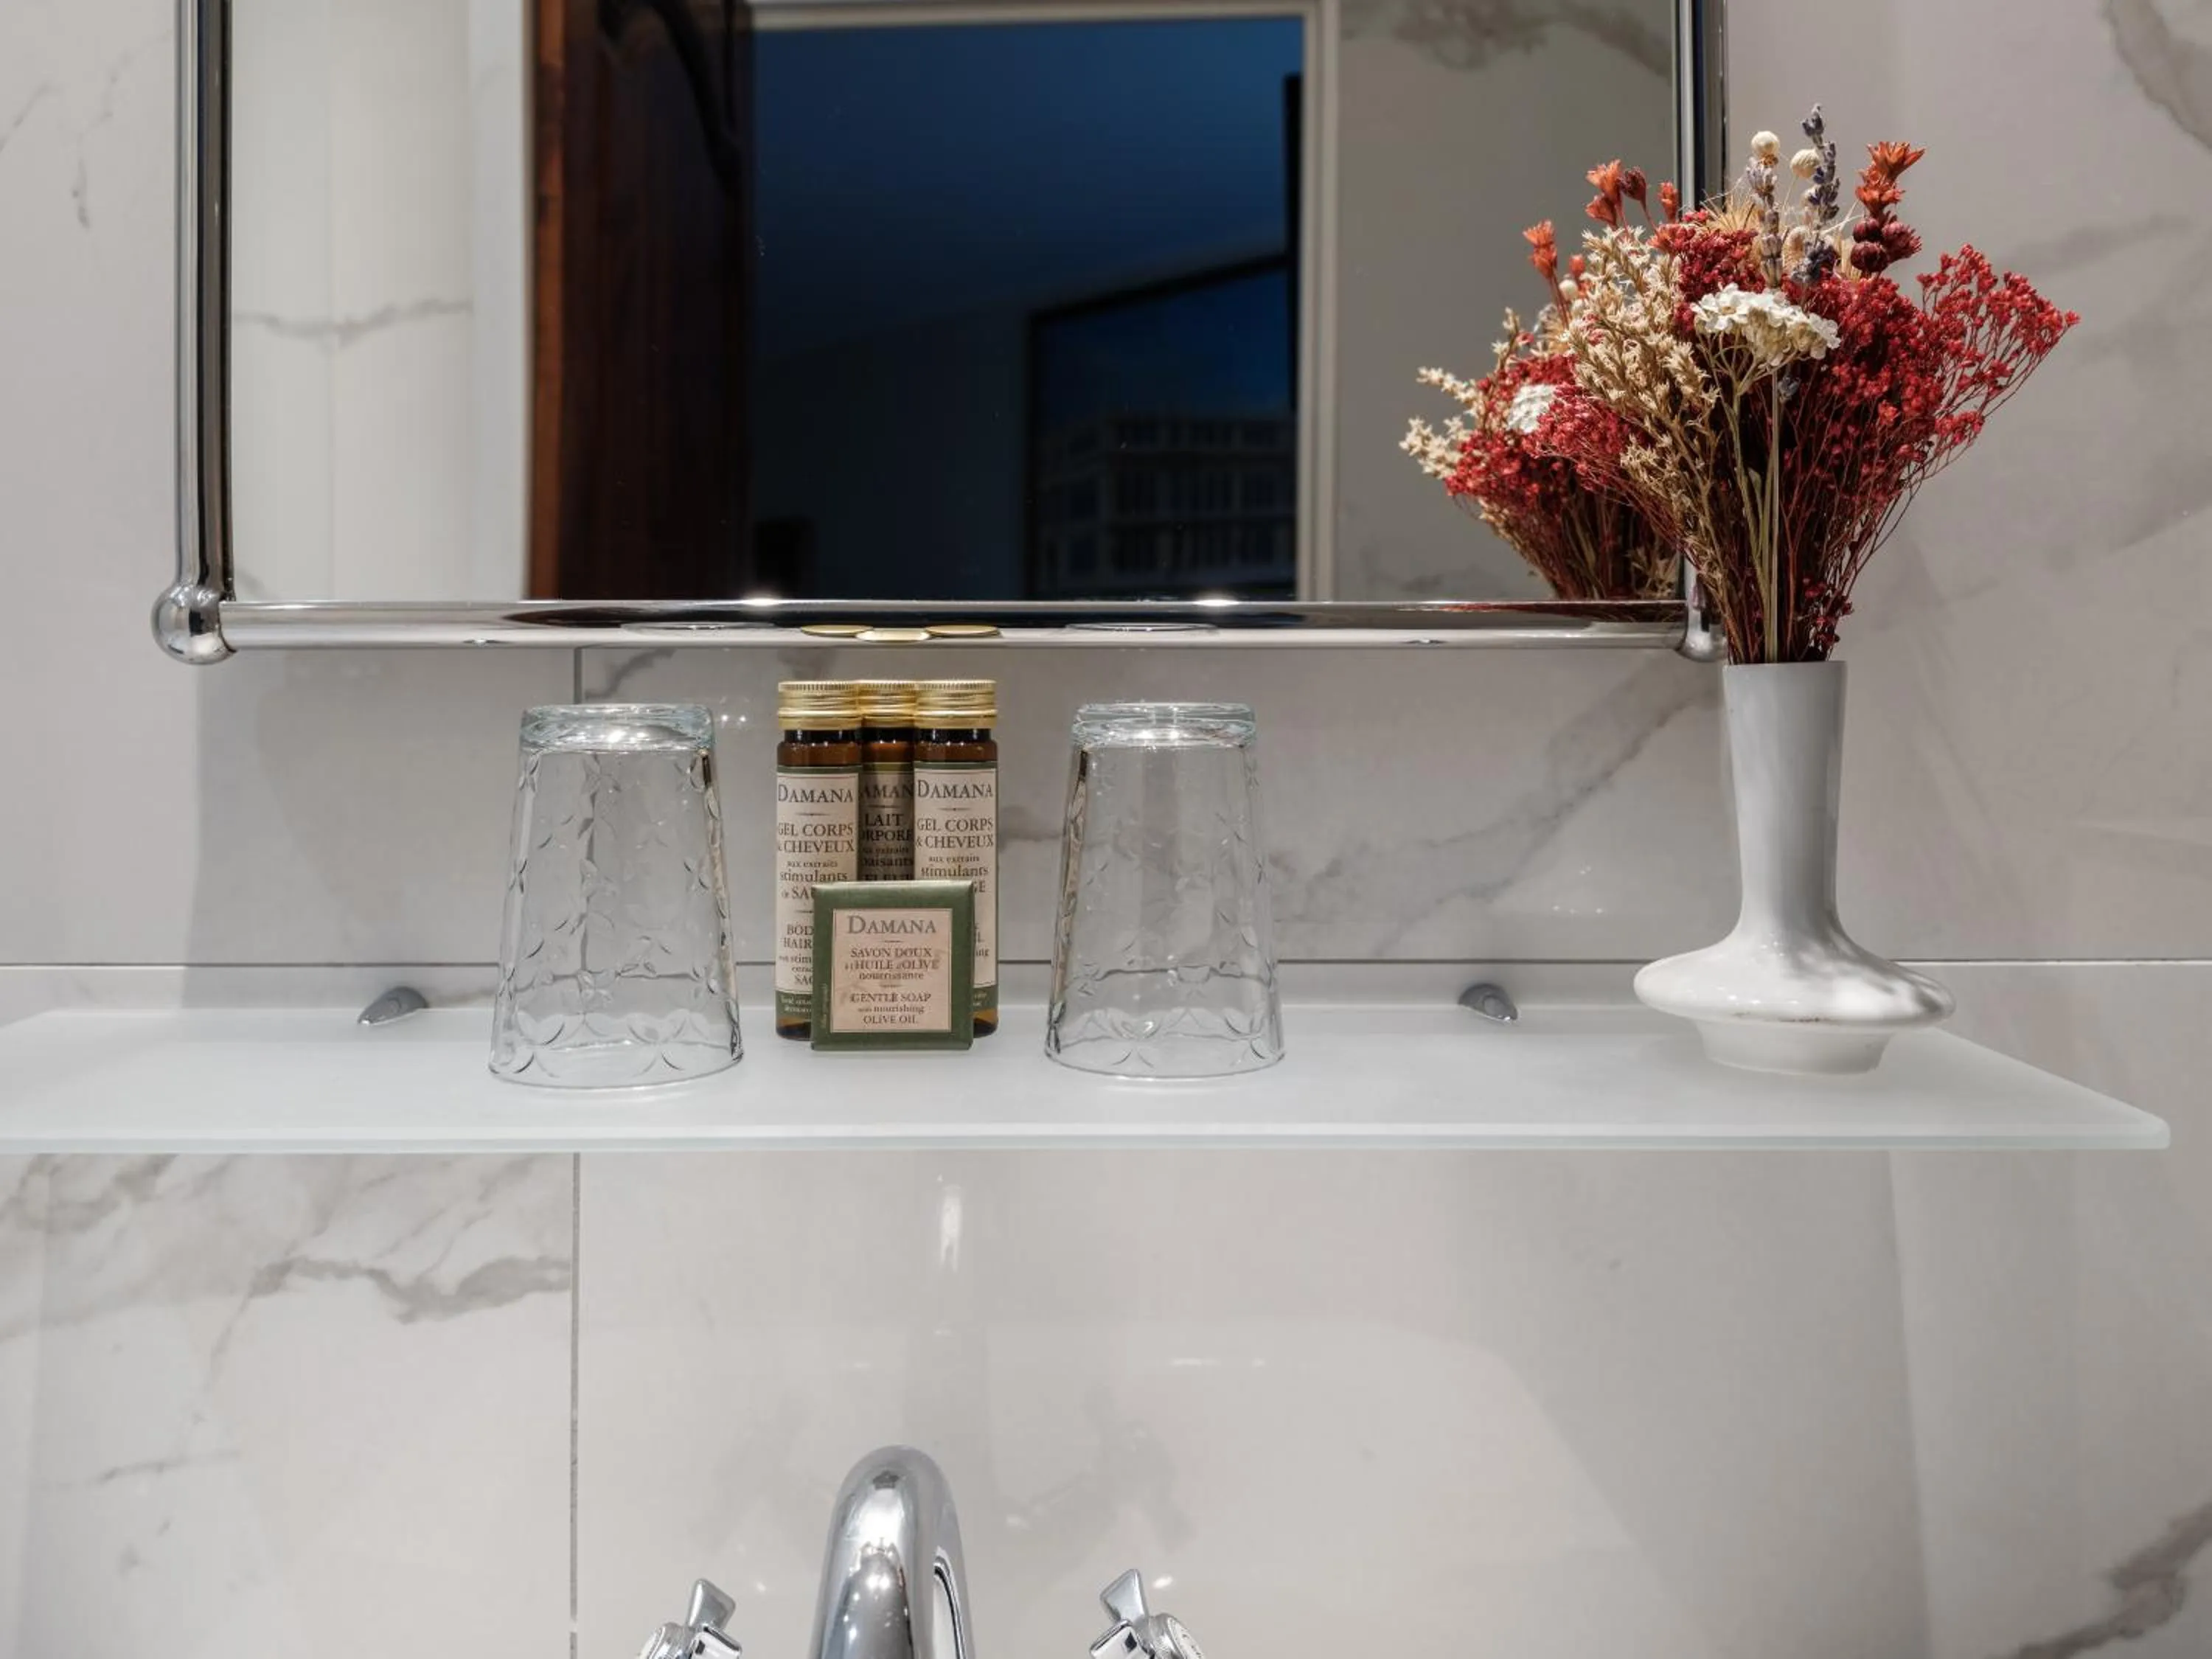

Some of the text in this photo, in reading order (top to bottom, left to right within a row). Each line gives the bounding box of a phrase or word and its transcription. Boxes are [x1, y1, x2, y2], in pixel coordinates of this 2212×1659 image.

[778, 784, 854, 803] DAMANA
[859, 784, 914, 799] AMAN
[917, 779, 993, 799] DAMANA
[865, 813, 904, 827] LAIT
[917, 817, 993, 832] GEL CORPS
[802, 822, 854, 837] CORPS
[784, 839, 855, 853] CHEVEUX
[925, 835, 994, 849] CHEVEUX
[779, 869, 848, 883] stimulants
[921, 864, 990, 877] stimulants
[791, 886, 810, 900] SA
[787, 924, 814, 936] BOD
[846, 915, 937, 934] DAMANA
[850, 947, 933, 958] SAVON DOUX
[849, 992, 932, 1003] GENTLE SOAP
[874, 1004, 925, 1015] nourishing
[862, 1015, 919, 1025] OLIVE OIL
